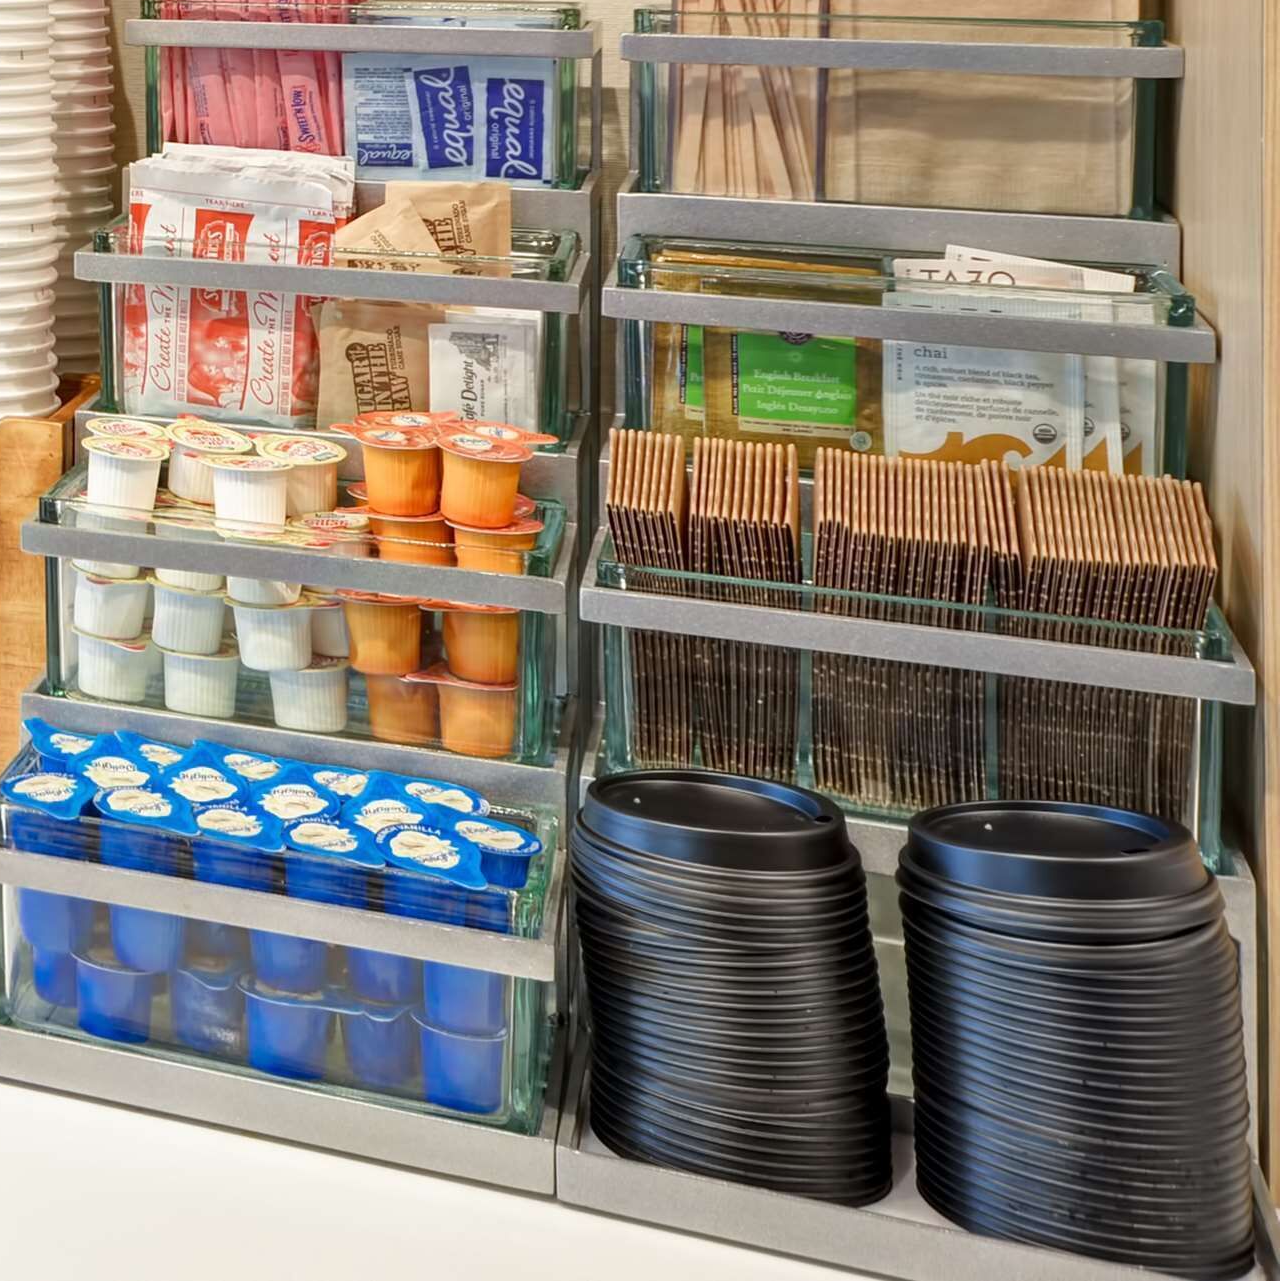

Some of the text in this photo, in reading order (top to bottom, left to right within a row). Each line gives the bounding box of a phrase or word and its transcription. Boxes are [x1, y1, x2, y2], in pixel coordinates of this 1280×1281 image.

[419, 67, 474, 167] equal
[458, 85, 472, 121] original
[490, 78, 538, 178] equal
[491, 123, 502, 160] original
[359, 144, 413, 165] equal
[149, 327, 172, 391] Create
[250, 317, 276, 404] Create THE
[368, 343, 390, 384] THE
[913, 346, 948, 360] chai
[352, 358, 375, 414] UGAR
[460, 359, 477, 401] Delight
[743, 384, 765, 394] Petit
[753, 369, 840, 384] English Breakfast
[968, 368, 991, 377] blend
[1002, 370, 1022, 380] black
[391, 375, 411, 411] RAW
[788, 402, 839, 415] Desayuno
